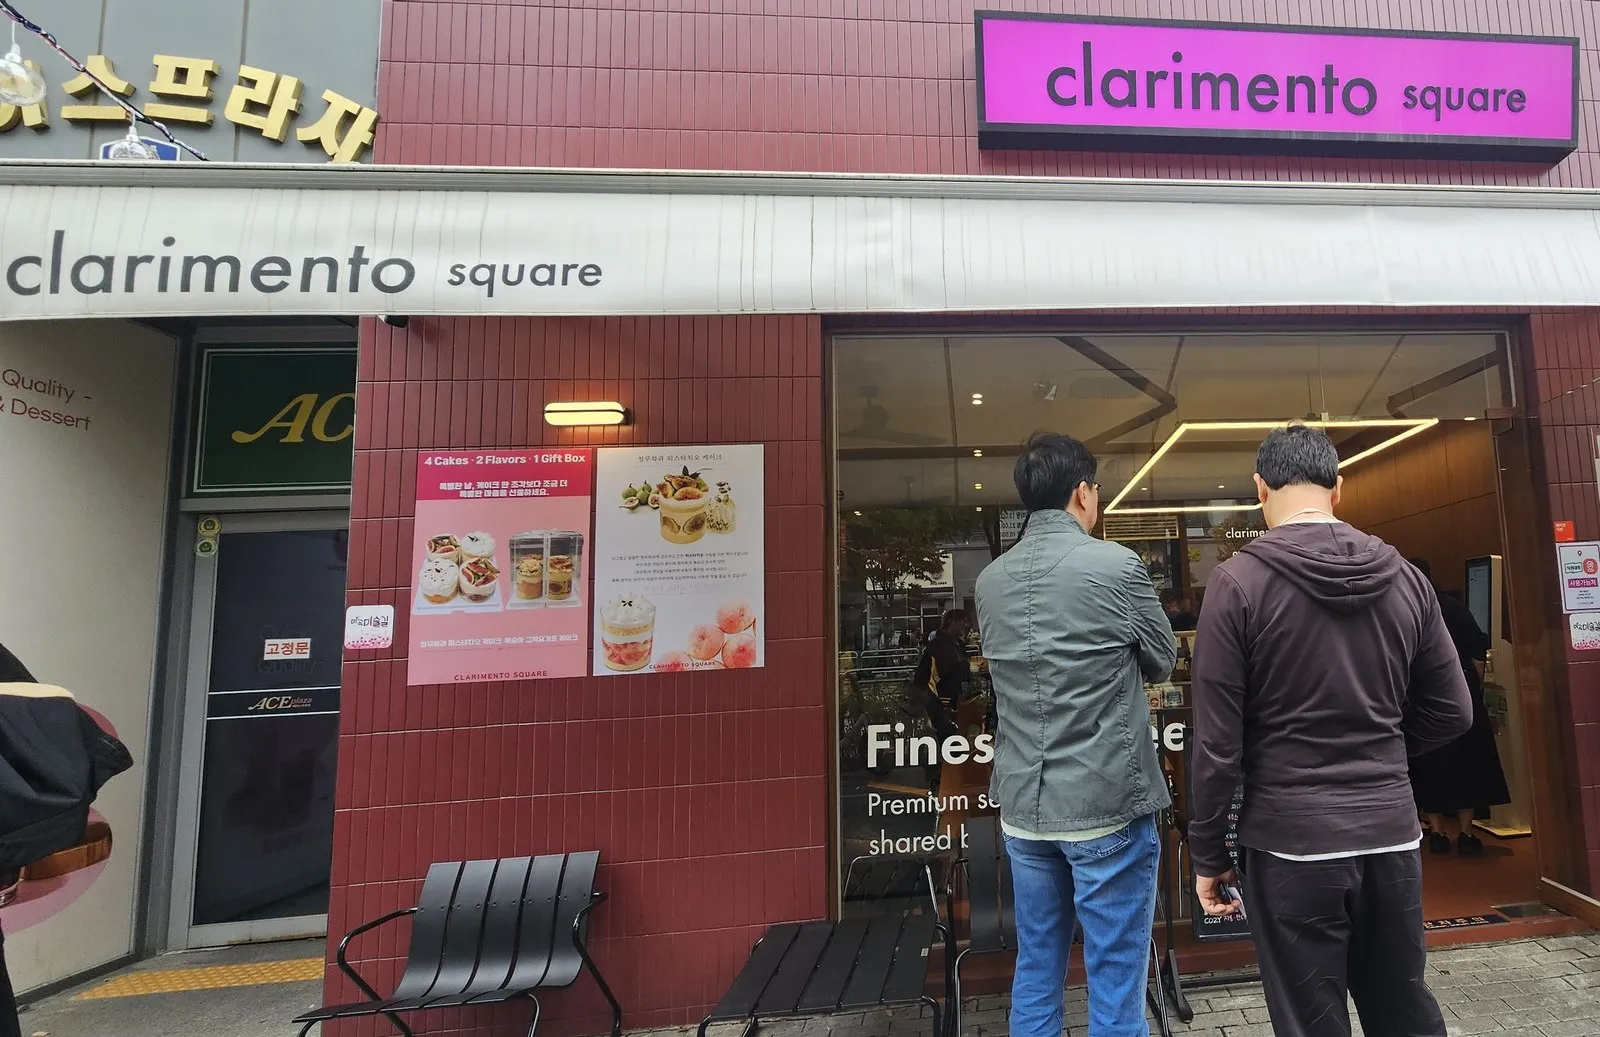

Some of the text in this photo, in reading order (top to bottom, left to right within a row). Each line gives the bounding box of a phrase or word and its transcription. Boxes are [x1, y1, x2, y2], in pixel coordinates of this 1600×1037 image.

[1046, 41, 1527, 121] clarimento square
[6, 230, 602, 298] clarimento square
[2, 368, 76, 404] Quality
[11, 398, 91, 431] Dessert
[231, 392, 356, 443] AC
[424, 453, 586, 466] 4 Cakes 2 Flavors 1 Gift Box
[702, 453, 723, 461] 케이크
[477, 481, 500, 489] 케이크
[1225, 527, 1269, 539] clarime
[265, 641, 310, 656] 고정문
[454, 670, 548, 681] CLARIMENTO SQUARE
[867, 722, 995, 768] Fines
[868, 791, 968, 817] Premium
[869, 824, 951, 856] shared
